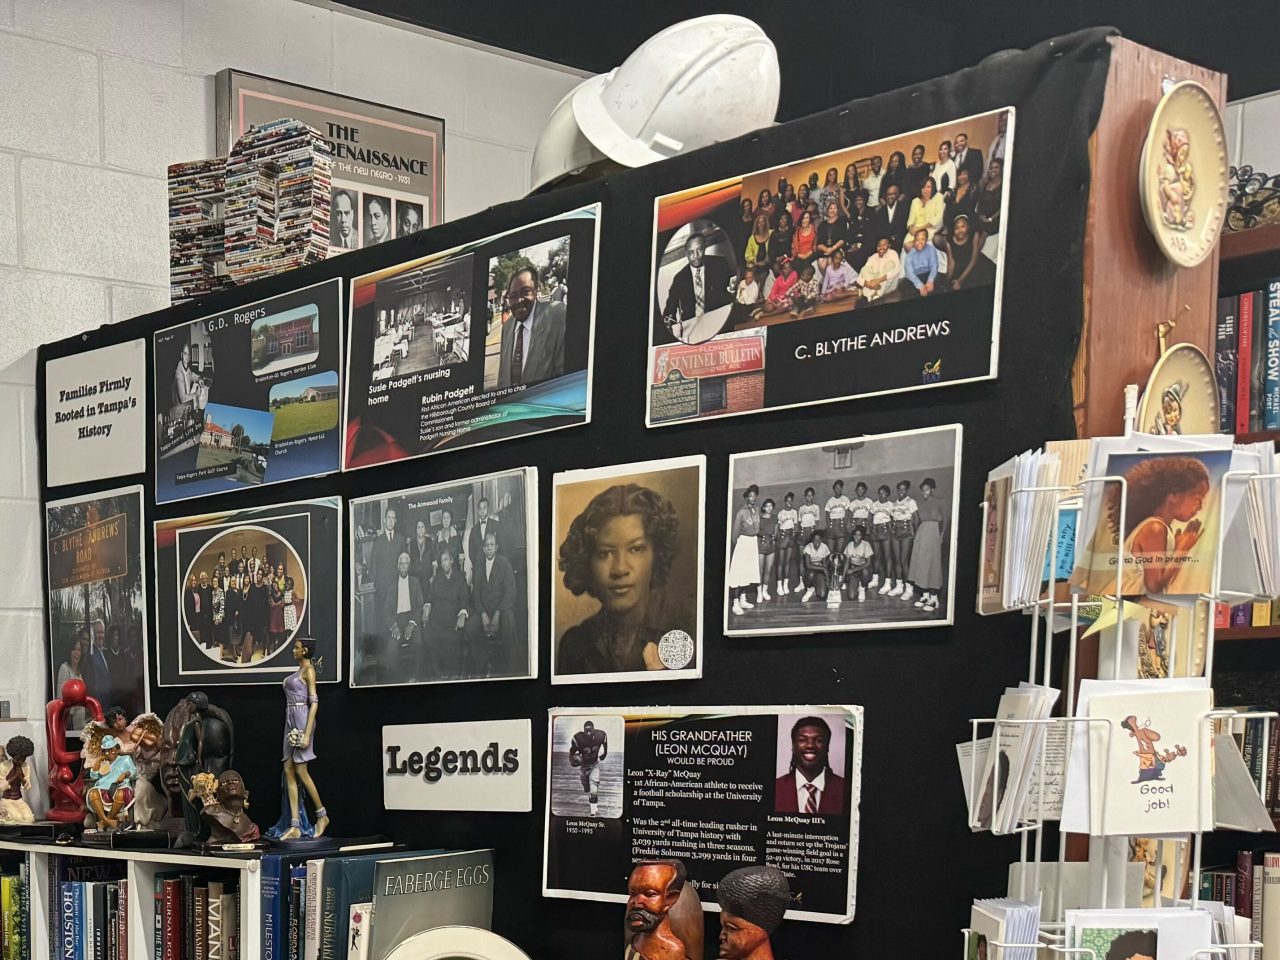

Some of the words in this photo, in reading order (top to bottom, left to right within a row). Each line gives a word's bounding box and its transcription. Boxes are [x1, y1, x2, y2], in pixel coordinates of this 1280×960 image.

[326, 122, 359, 143] THE
[339, 163, 351, 172] THE
[354, 166, 369, 176] NEW
[371, 170, 393, 180] NEGRO
[208, 319, 228, 332] G.D.
[234, 307, 266, 325] Rogers
[794, 345, 811, 360] C.
[815, 335, 867, 358] BLYTHE
[870, 320, 951, 348] ANDREWS
[671, 351, 717, 369] SENTINEL
[719, 345, 761, 363] BULLETIN
[1268, 340, 1279, 380] SHOW
[59, 384, 98, 402] Families
[98, 375, 132, 396] Firmly
[368, 381, 387, 394] Susie
[388, 374, 422, 391] Padgett's
[424, 368, 450, 383] nursing
[368, 394, 389, 406] home
[421, 393, 442, 405] Rubin
[444, 385, 474, 400] Padgett
[54, 407, 84, 424] Rooted
[86, 405, 96, 417] in
[98, 396, 137, 417] Tampa's
[78, 422, 112, 440] History
[89, 522, 118, 543] ANDREWS
[76, 548, 91, 563] ROAD
[1135, 557, 1152, 565] God
[651, 730, 666, 741] HIS
[670, 731, 752, 741] GRANDFATHER
[655, 744, 688, 756] (LEON
[691, 745, 748, 757] MCQUAY)
[386, 742, 520, 783] Legends
[667, 757, 695, 765] WOULD
[697, 757, 705, 765] BE
[708, 757, 734, 766] PROUD
[627, 769, 644, 777] Leon
[645, 769, 672, 778] "X-Ray"
[673, 771, 701, 779] McQuay
[1139, 783, 1174, 795] Good
[1144, 799, 1170, 814] job!
[456, 864, 489, 888] EGGS
[195, 895, 203, 908] THE
[64, 891, 73, 959] HOUSTON
[155, 930, 163, 942] THE
